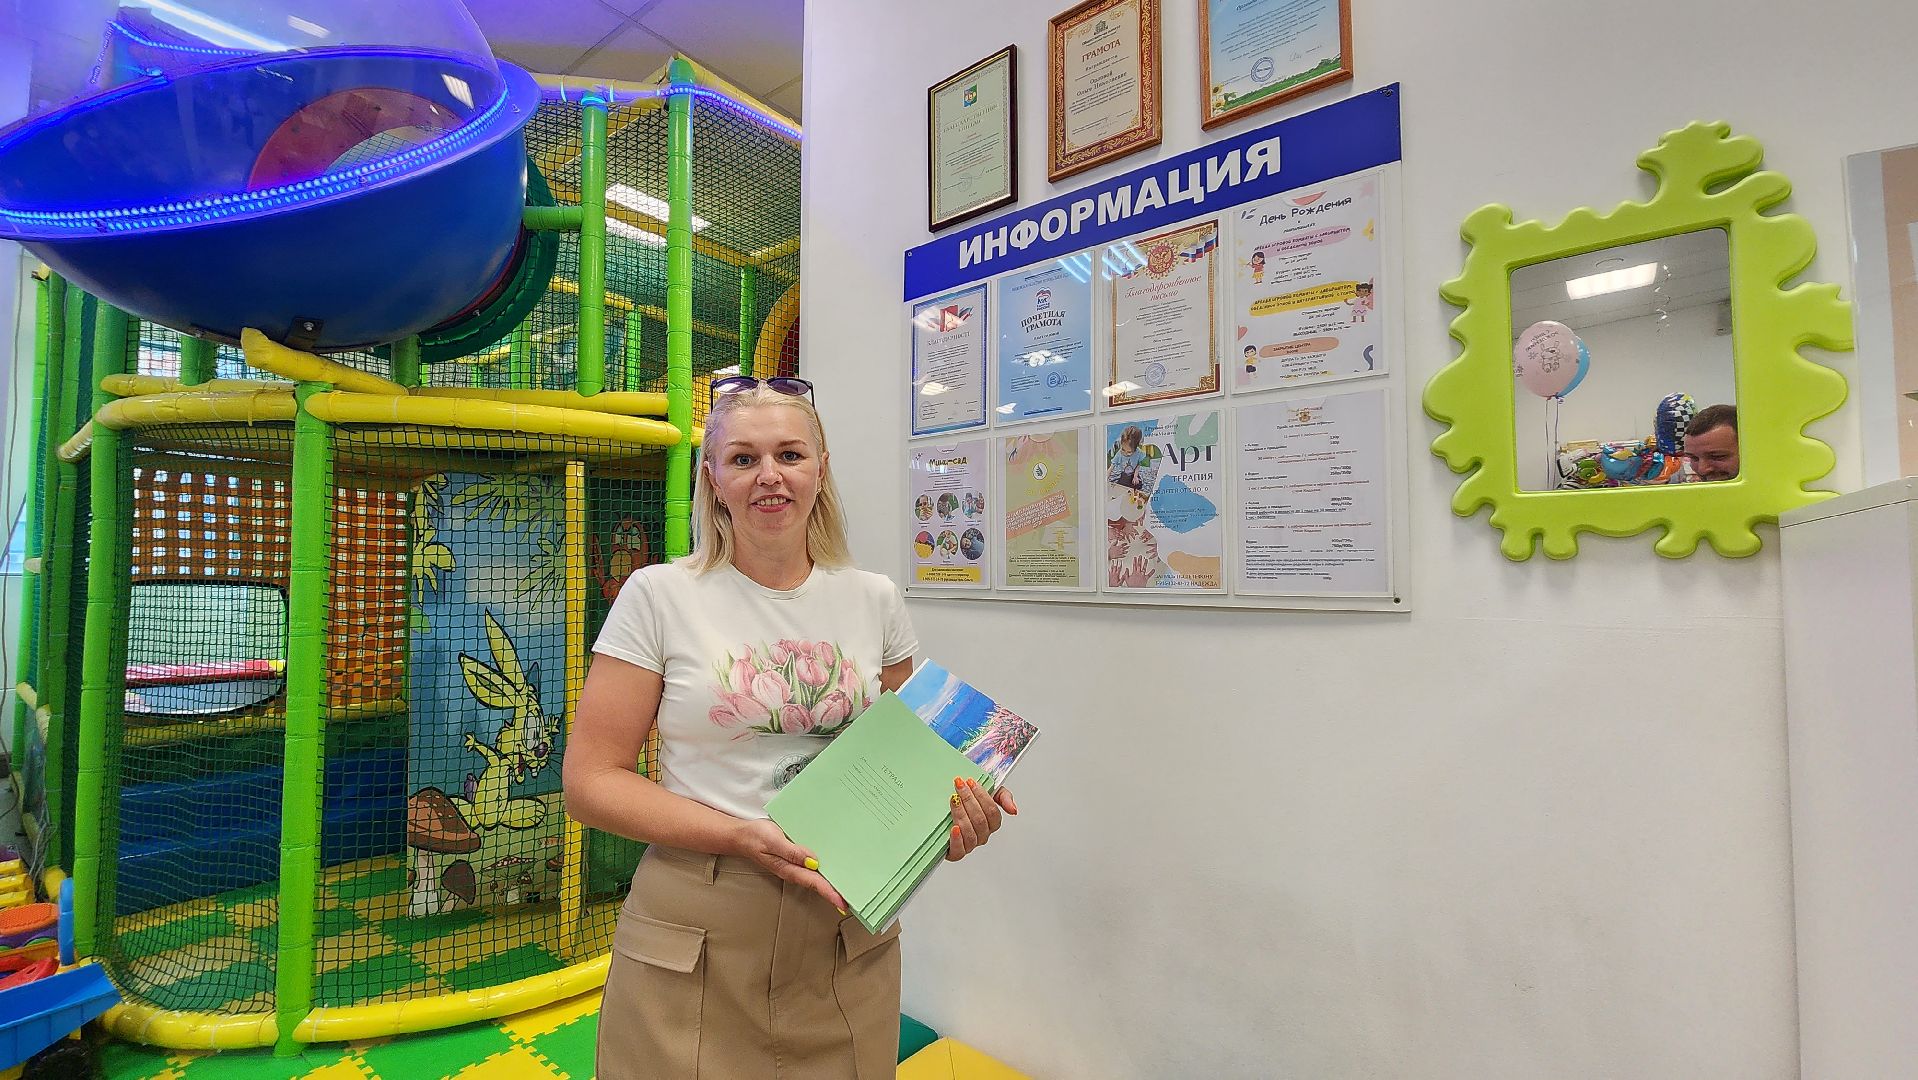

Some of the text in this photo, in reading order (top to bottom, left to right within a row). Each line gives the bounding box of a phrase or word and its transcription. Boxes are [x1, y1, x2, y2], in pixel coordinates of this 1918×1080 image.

[1081, 38, 1121, 62] ГРАМОТА
[958, 136, 1282, 270] ИНФОРМАЦИЯ
[1260, 197, 1352, 226] День Рождения
[1124, 275, 1202, 298] Благодарственное
[1150, 290, 1178, 302] письмо
[1020, 310, 1066, 328] ПОЧЕТНАЯ
[1026, 319, 1062, 334] ГРАМОТА
[1172, 472, 1213, 482] ТЕРАПИЯ
[881, 764, 904, 789] ТЕТРАДЬ
